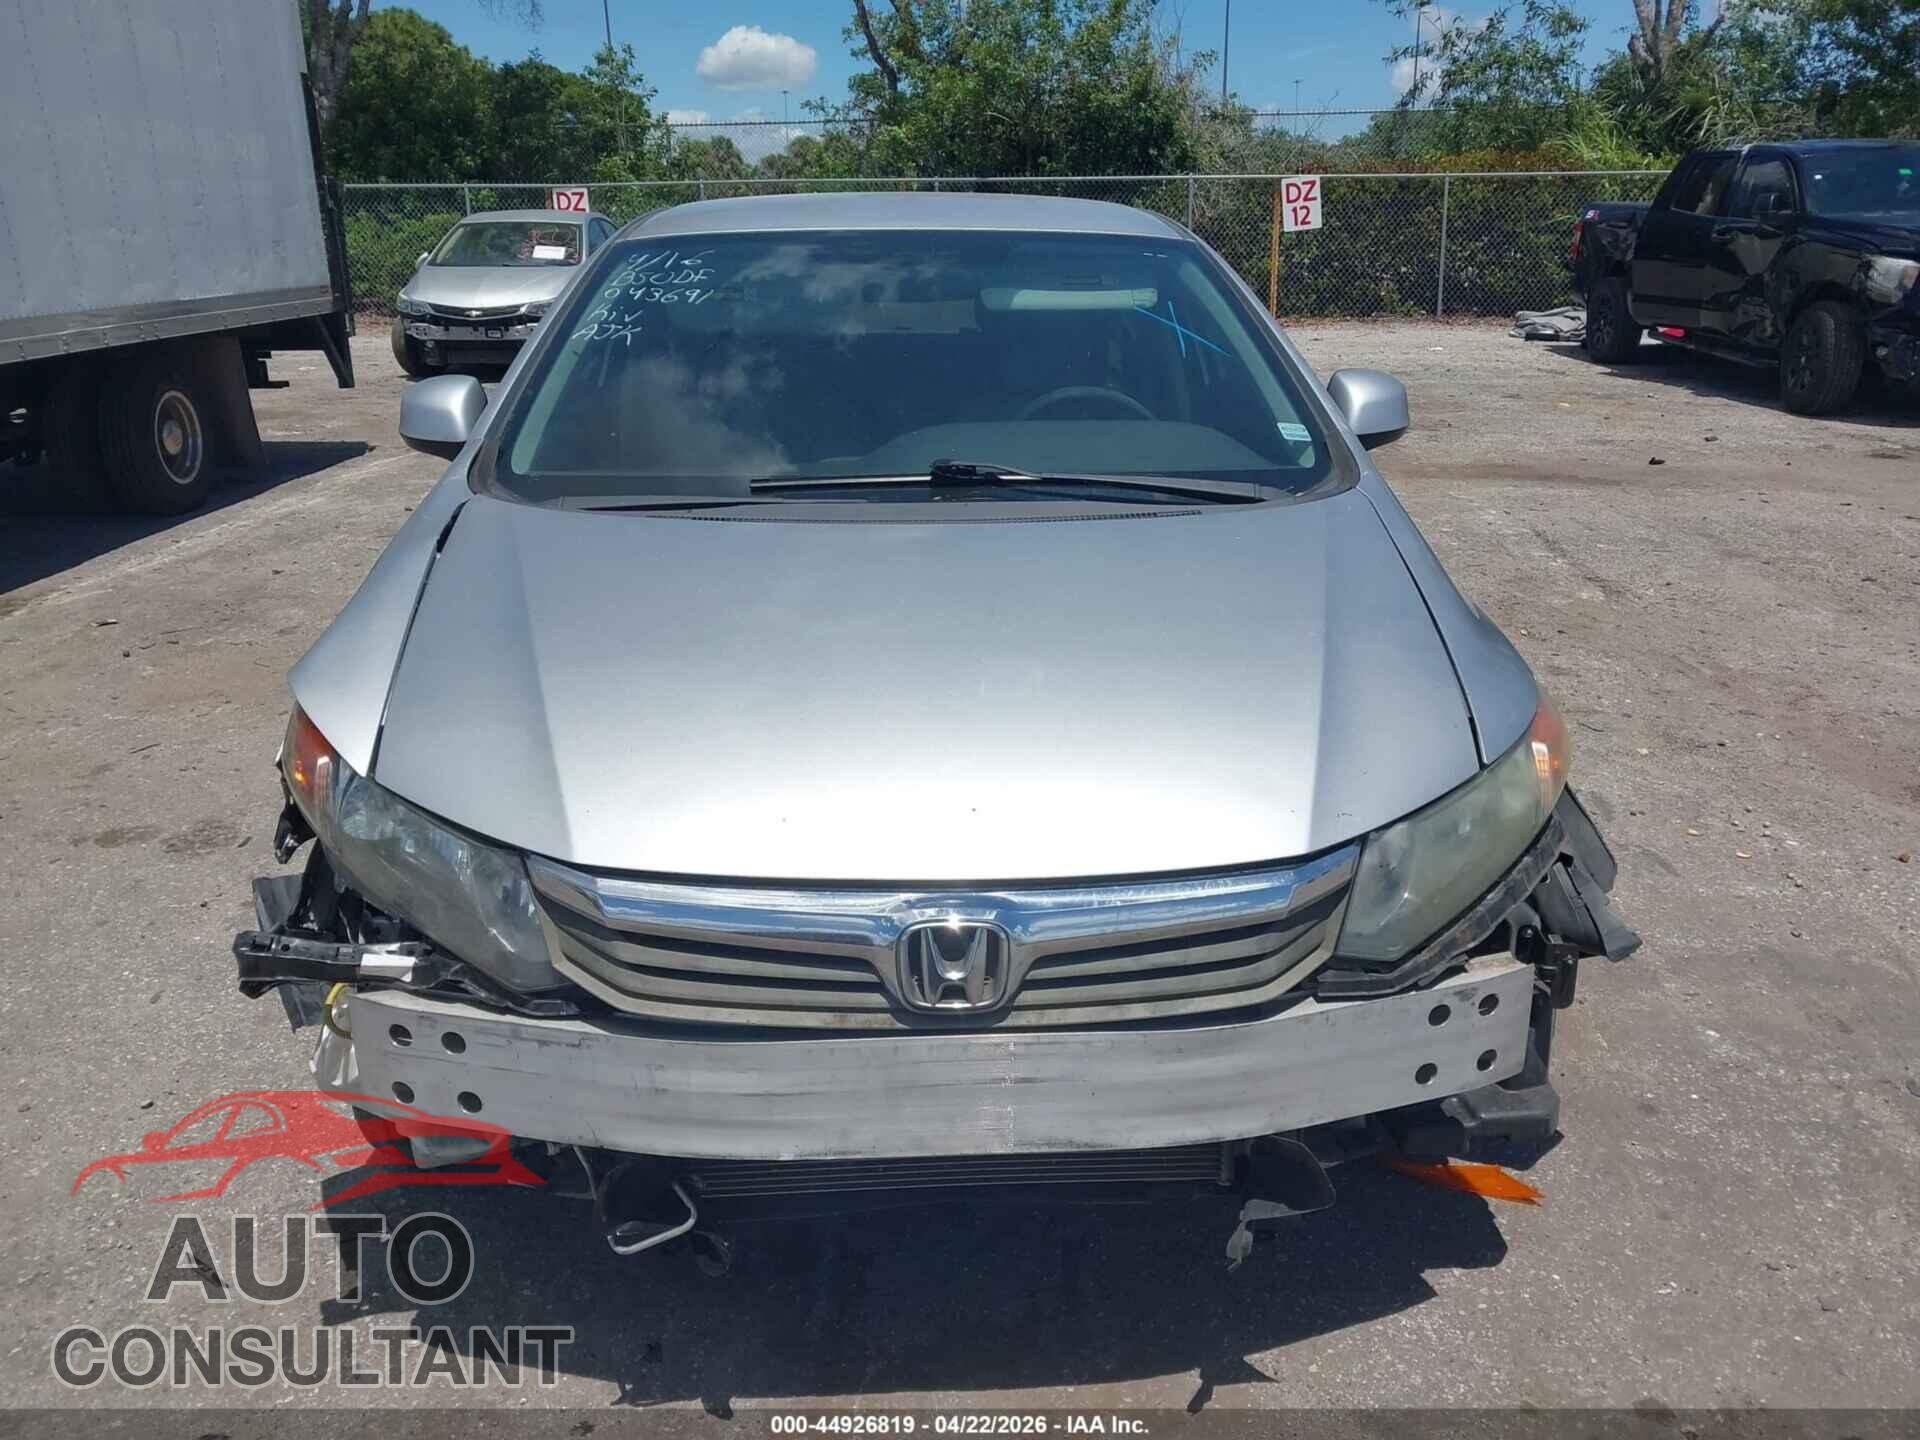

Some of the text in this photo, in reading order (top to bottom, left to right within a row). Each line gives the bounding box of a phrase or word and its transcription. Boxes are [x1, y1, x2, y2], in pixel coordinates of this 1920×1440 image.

[556, 191, 586, 212] DZ
[1285, 180, 1318, 204] DZ
[1291, 205, 1311, 226] 12
[627, 250, 715, 271] 4/16
